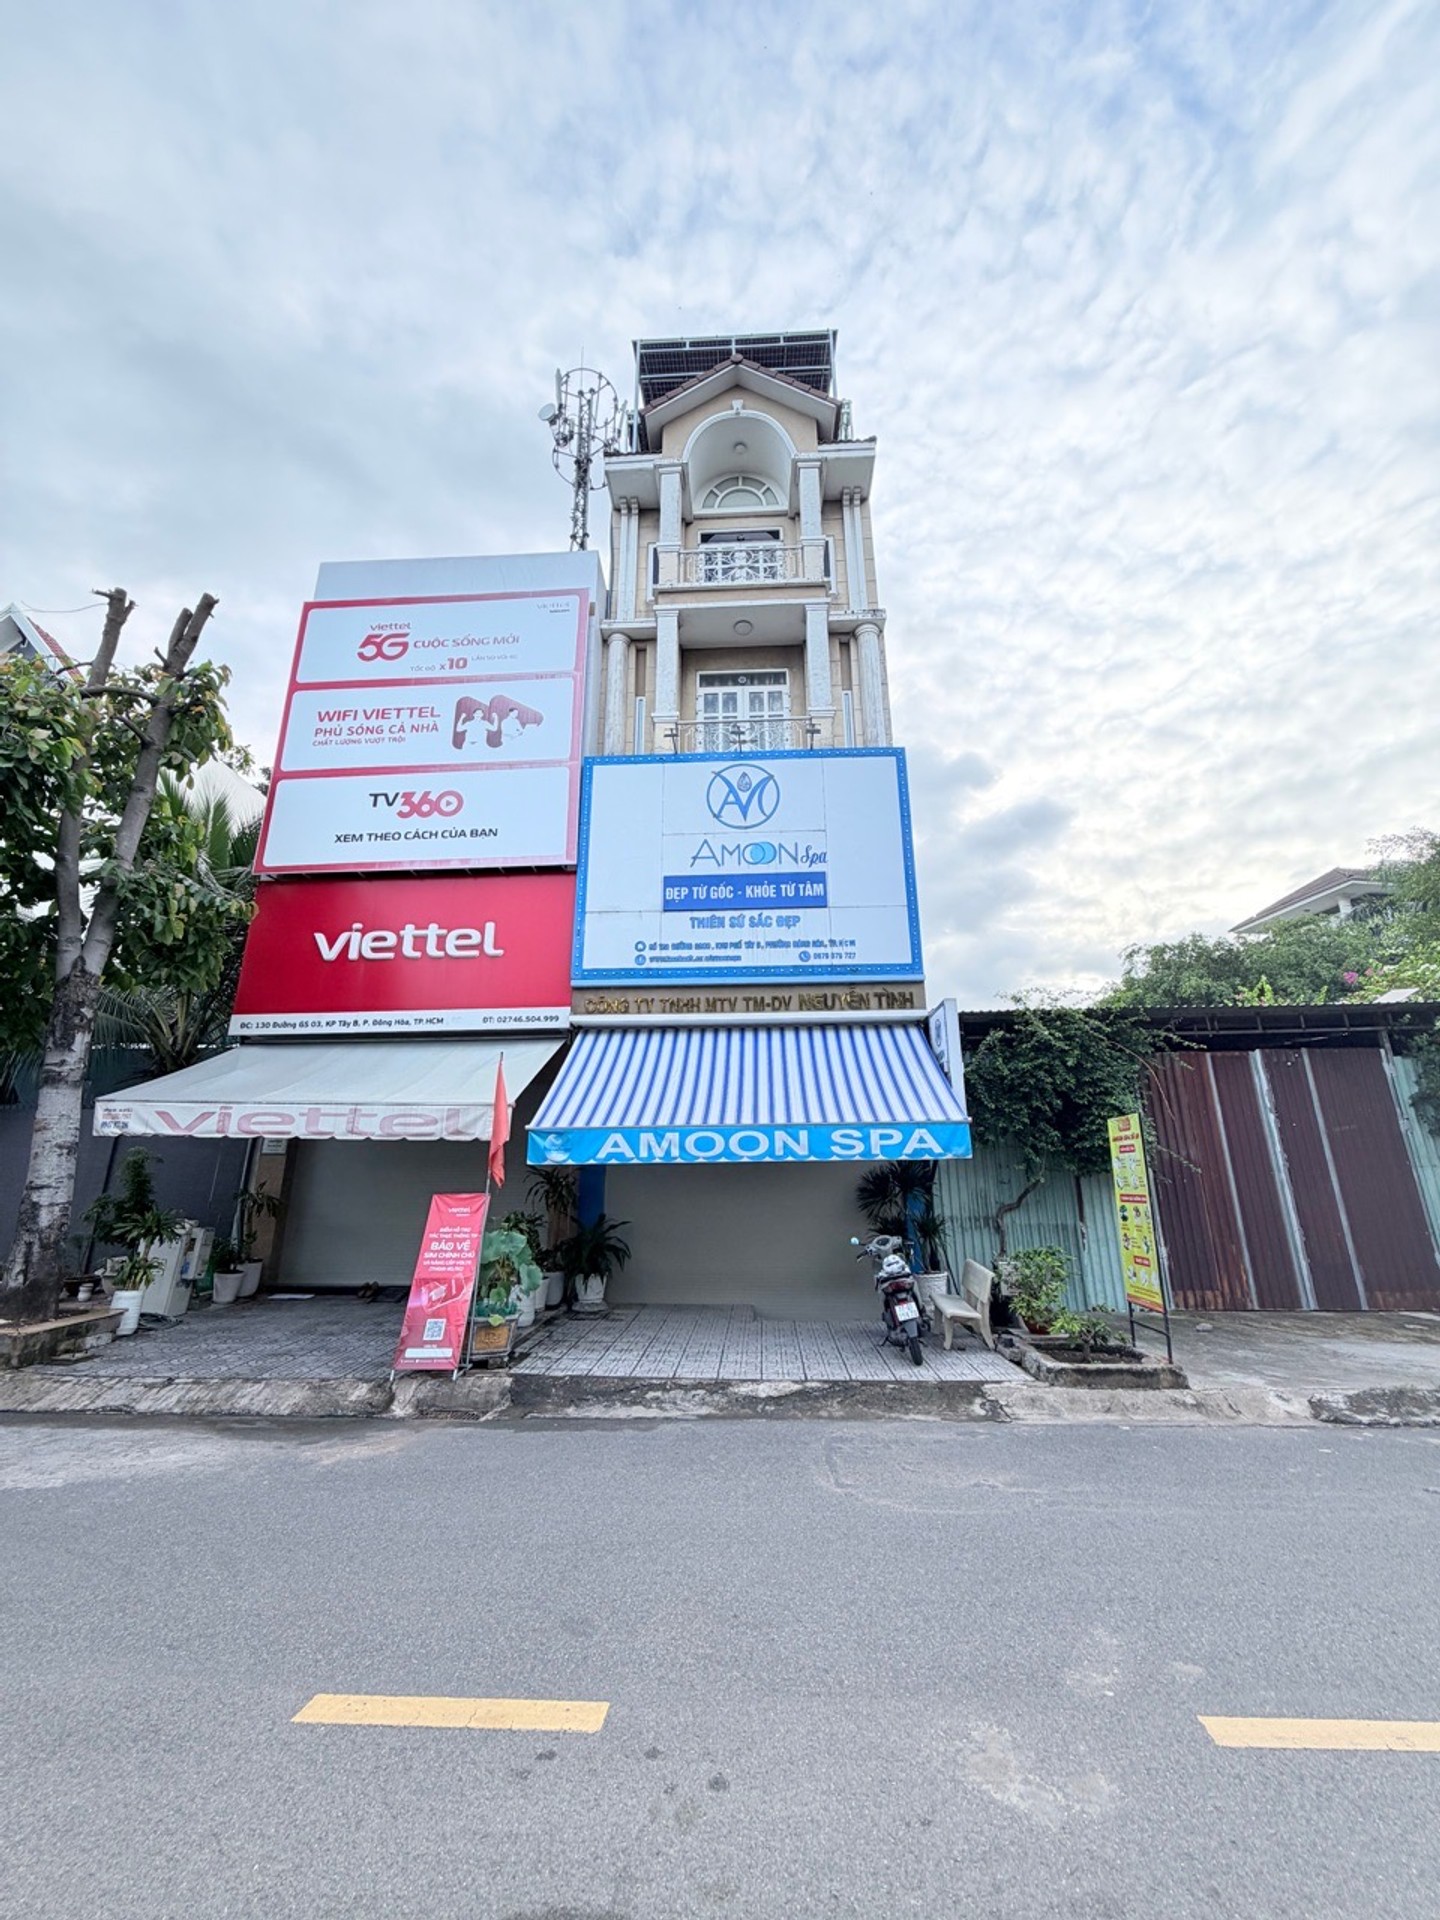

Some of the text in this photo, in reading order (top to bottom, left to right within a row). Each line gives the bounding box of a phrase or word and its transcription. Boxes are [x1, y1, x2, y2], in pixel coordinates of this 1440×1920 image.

[370, 622, 412, 632] viettel
[357, 632, 410, 662] 5G
[413, 638, 450, 650] CUỘC
[452, 633, 490, 648] SỐNG
[318, 706, 441, 722] WIFI VIETTEL
[314, 724, 343, 737] PHỦ
[346, 723, 384, 736] SÓNG
[410, 720, 439, 733] NHÀ
[368, 790, 464, 819] TV360
[334, 826, 498, 844] XEM THEO CÁCH CỦA BẠN
[690, 838, 828, 868] AMOON Spa
[665, 886, 689, 903] ĐẸP
[692, 884, 708, 900] TỪ
[710, 881, 734, 898] GỐC
[745, 880, 777, 898] KHỎE
[780, 881, 796, 897] TỪ
[800, 880, 824, 897] TÂM
[689, 914, 726, 929] THIÊN
[748, 912, 772, 928] SẮC
[776, 914, 800, 930] ĐẸP
[313, 920, 505, 962] viettel
[584, 986, 915, 1014] CÔNG TY TNHH MTV TM-DV NGUYỄN TÌNH
[326, 1020, 337, 1028] KP
[338, 1019, 352, 1028] Tây
[372, 1018, 392, 1027] Đông
[496, 1014, 560, 1024] 02746.504.999
[154, 1104, 480, 1138] viettel
[597, 1128, 946, 1159] AMOON SPA
[430, 1239, 454, 1250] BẢO
